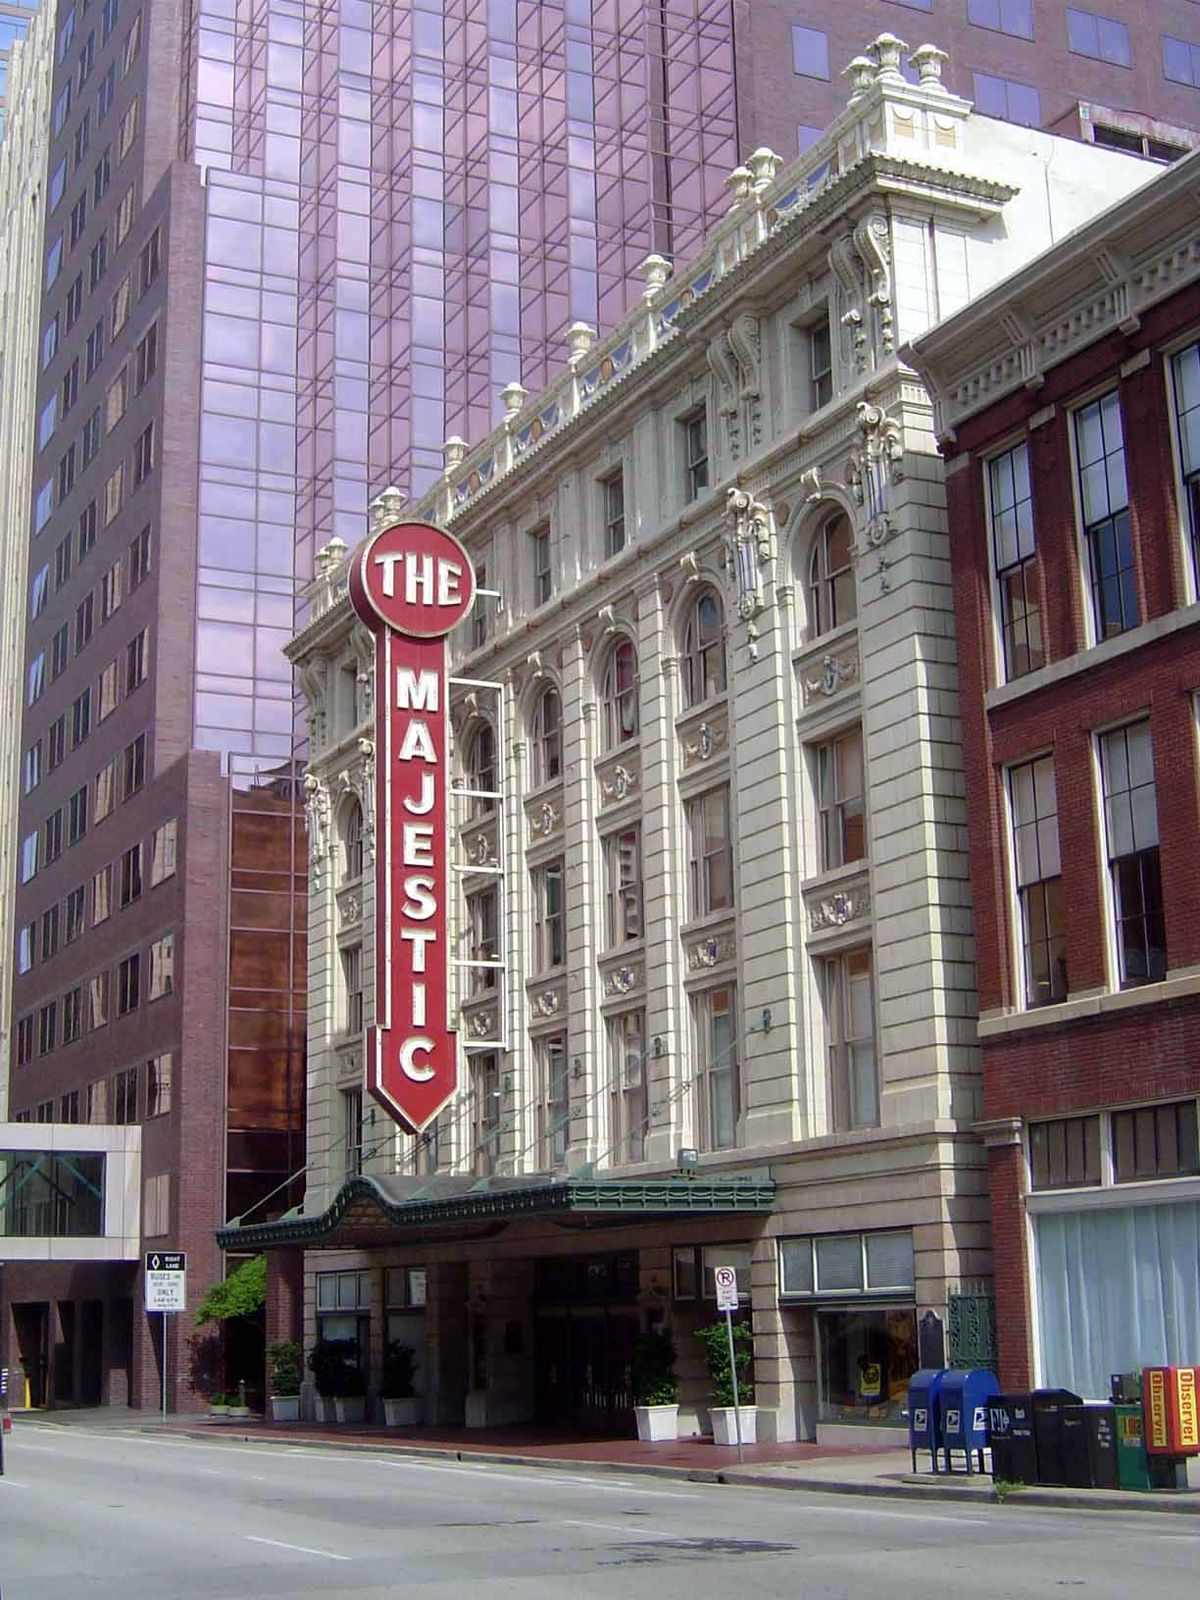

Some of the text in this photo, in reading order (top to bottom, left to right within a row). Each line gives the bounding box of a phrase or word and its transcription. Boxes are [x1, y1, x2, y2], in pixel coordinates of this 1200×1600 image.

[375, 551, 462, 606] THE
[396, 666, 439, 1082] MAJESTIC
[1152, 1374, 1164, 1445] Observer
[1181, 1372, 1194, 1443] Observer
